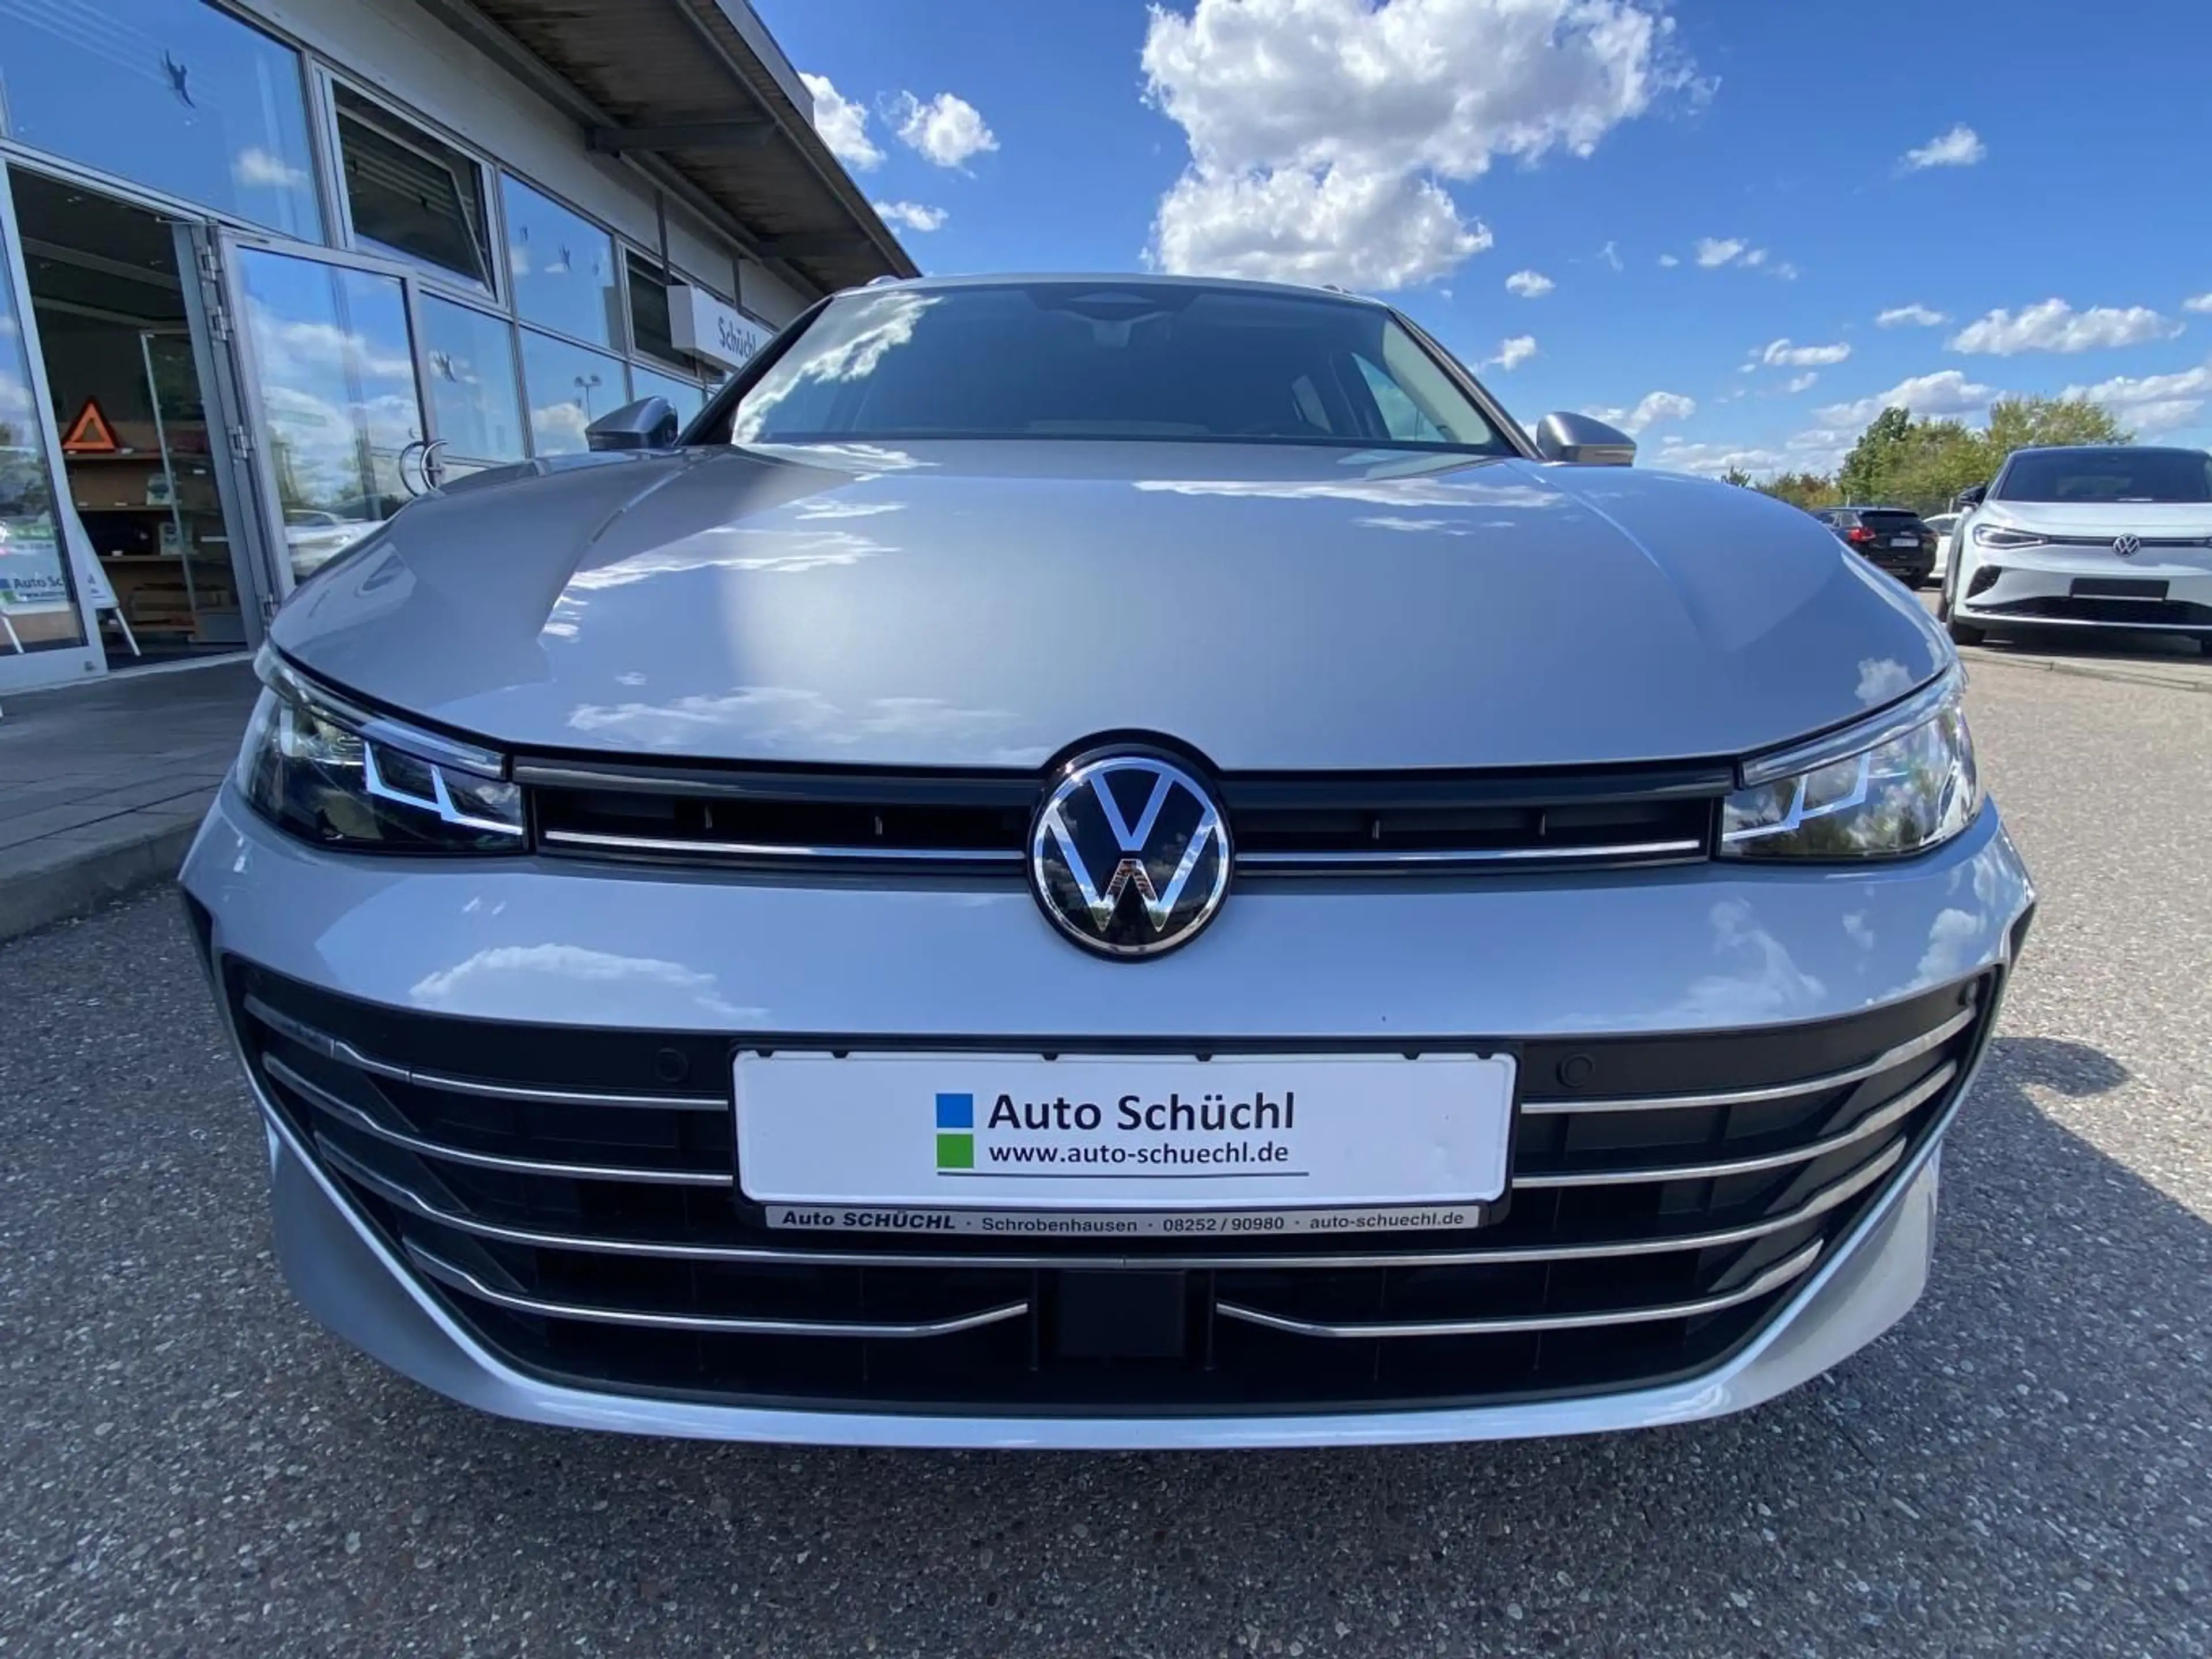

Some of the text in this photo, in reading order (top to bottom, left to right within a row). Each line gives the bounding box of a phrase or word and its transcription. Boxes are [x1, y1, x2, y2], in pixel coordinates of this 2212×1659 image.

[1040, 764, 1222, 936] VW
[988, 1092, 1294, 1131] Auto Schüchl
[989, 1141, 1288, 1164] www.auto-schuechl.de
[782, 1211, 835, 1226] Auto
[842, 1210, 955, 1229] SCHÜCHL
[982, 1217, 1137, 1233] Schrobenhausen
[1163, 1218, 1216, 1232] 08252
[1231, 1217, 1284, 1230] 90980
[1310, 1211, 1464, 1229] auto-schuechl.de
